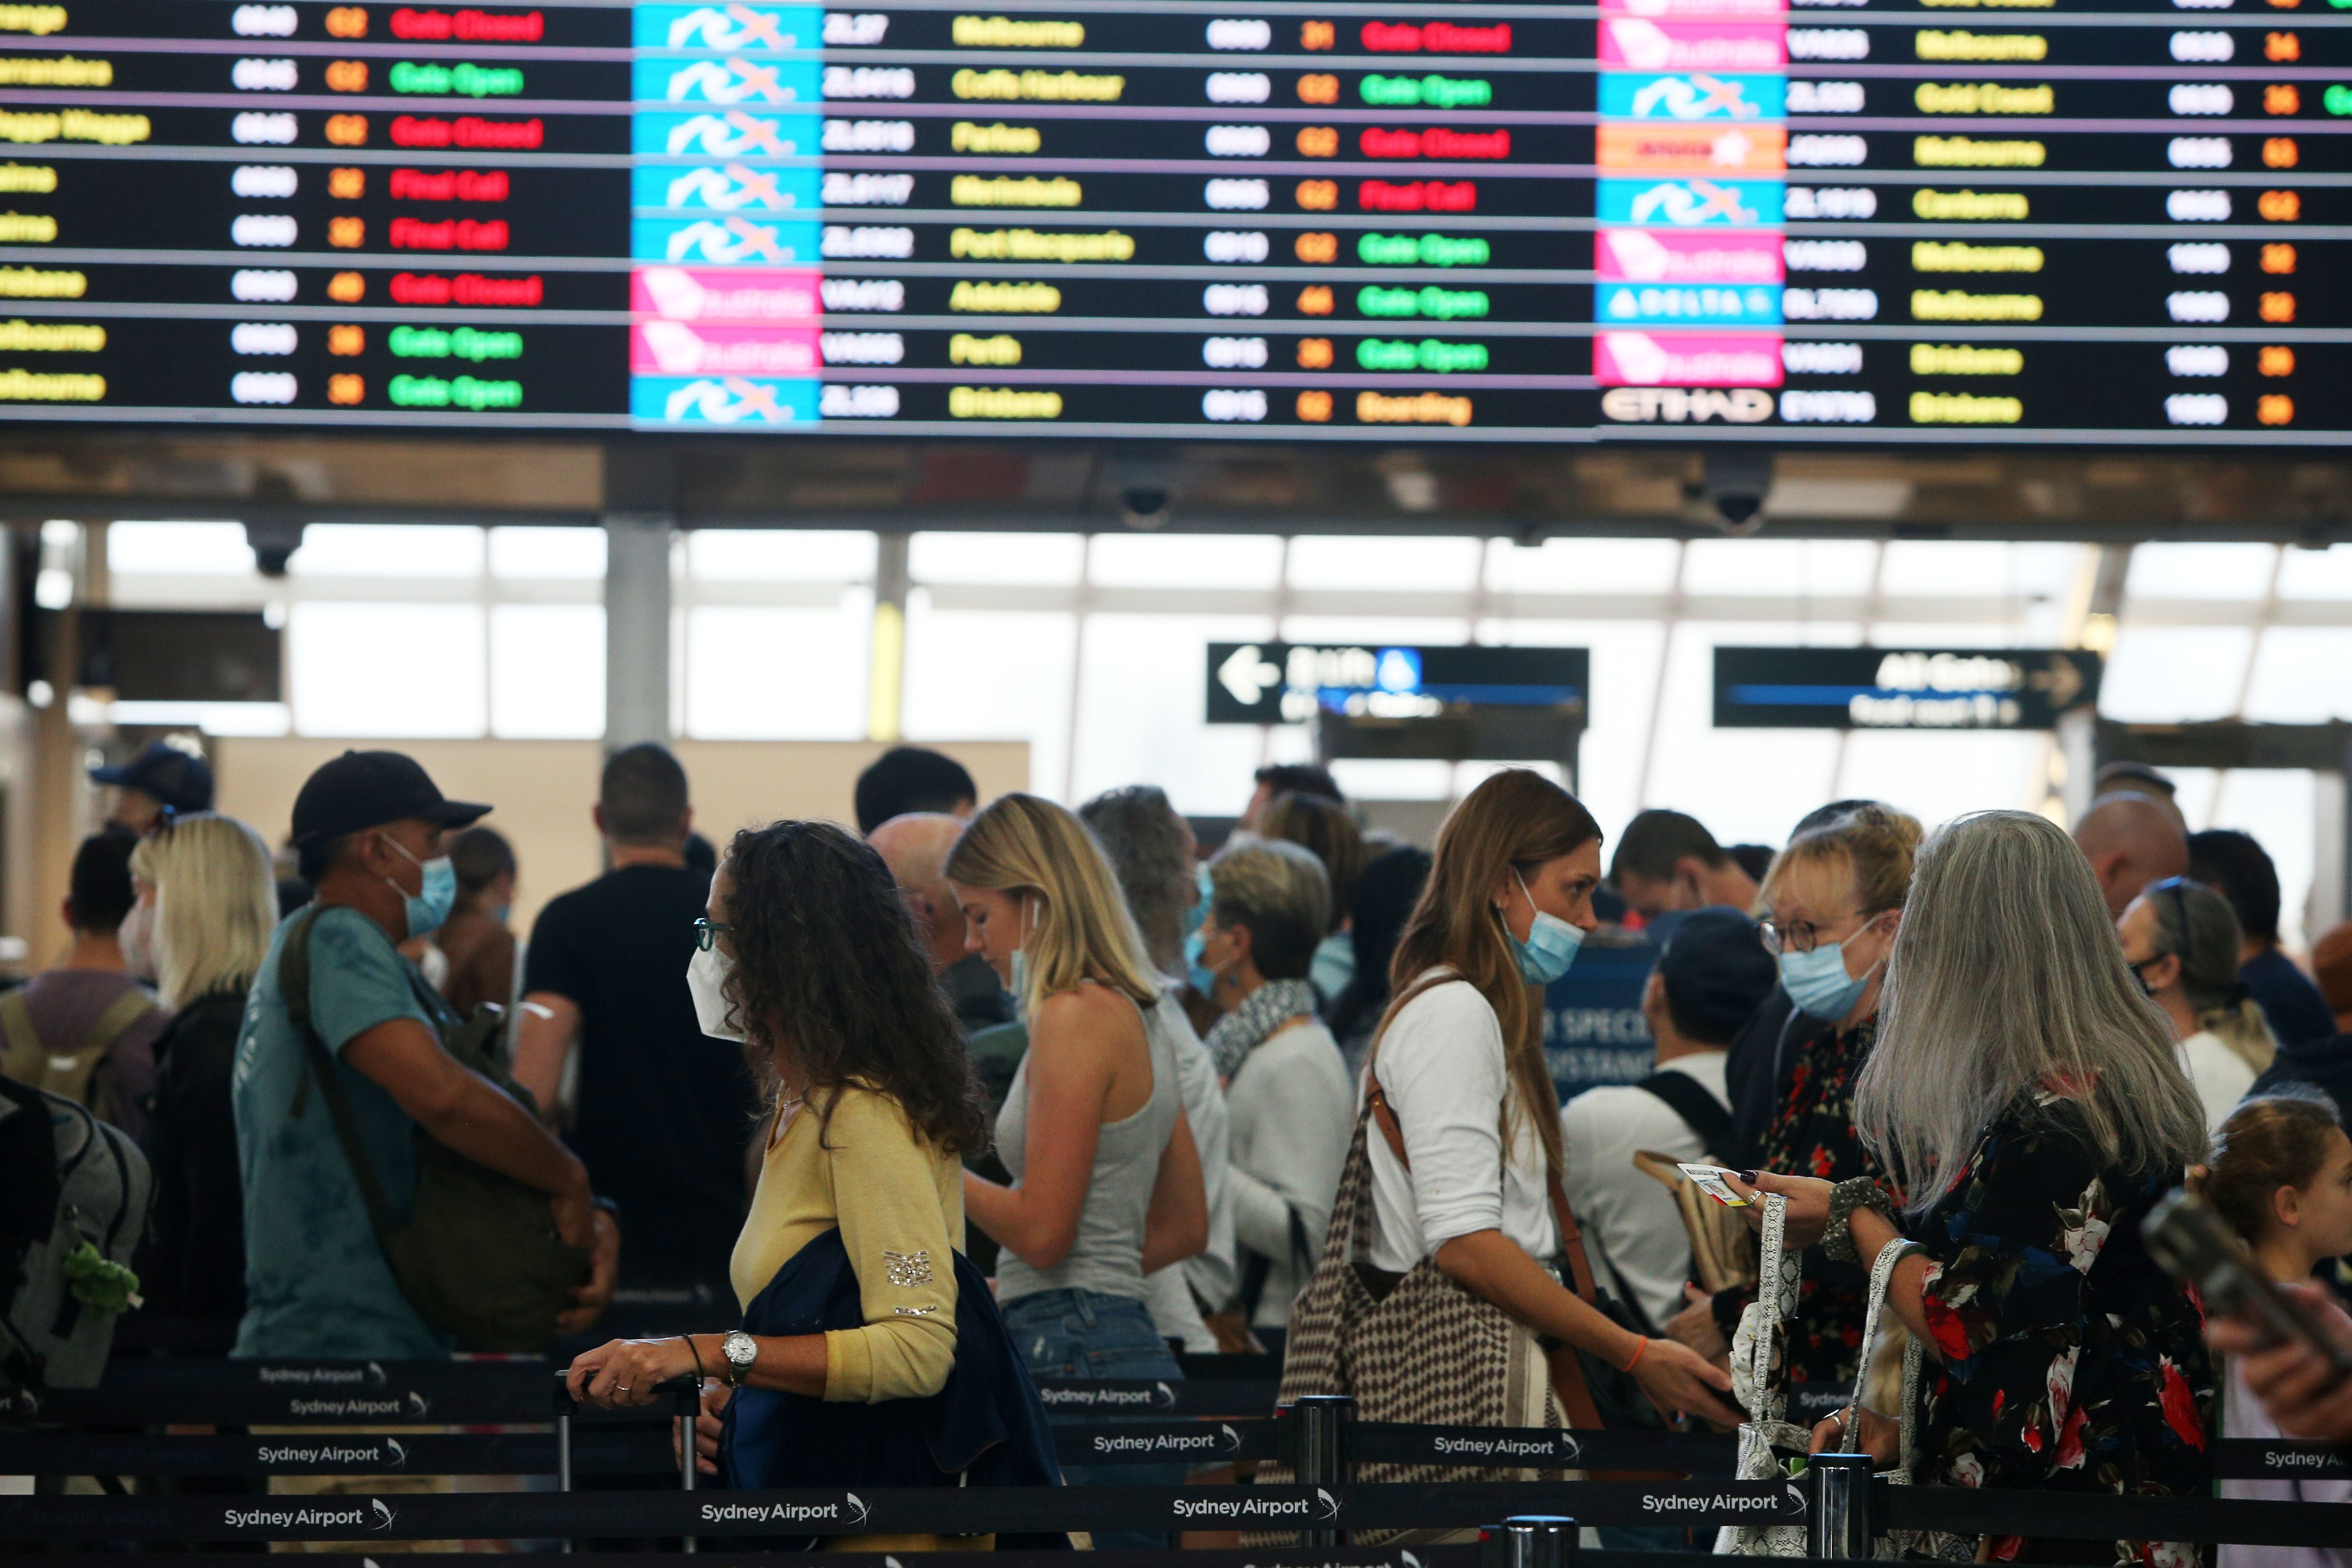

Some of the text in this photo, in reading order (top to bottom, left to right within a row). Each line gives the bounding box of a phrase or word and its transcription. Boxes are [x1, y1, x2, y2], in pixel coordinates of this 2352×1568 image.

[1602, 388, 1774, 423] ETIHAD
[1041, 1388, 1152, 1405] Sydney Airport
[1094, 1435, 1215, 1453] Sydney Airport
[1434, 1437, 1554, 1456] Sydney Airport
[258, 1447, 379, 1464] Sydney Airport
[2265, 1451, 2325, 1468] Sydney
[1173, 1499, 1308, 1518] Sydney Airport
[1642, 1495, 1778, 1513] Sydney Airport
[225, 1509, 363, 1528] Sydney Airport
[701, 1504, 838, 1523] Sydney Airport
